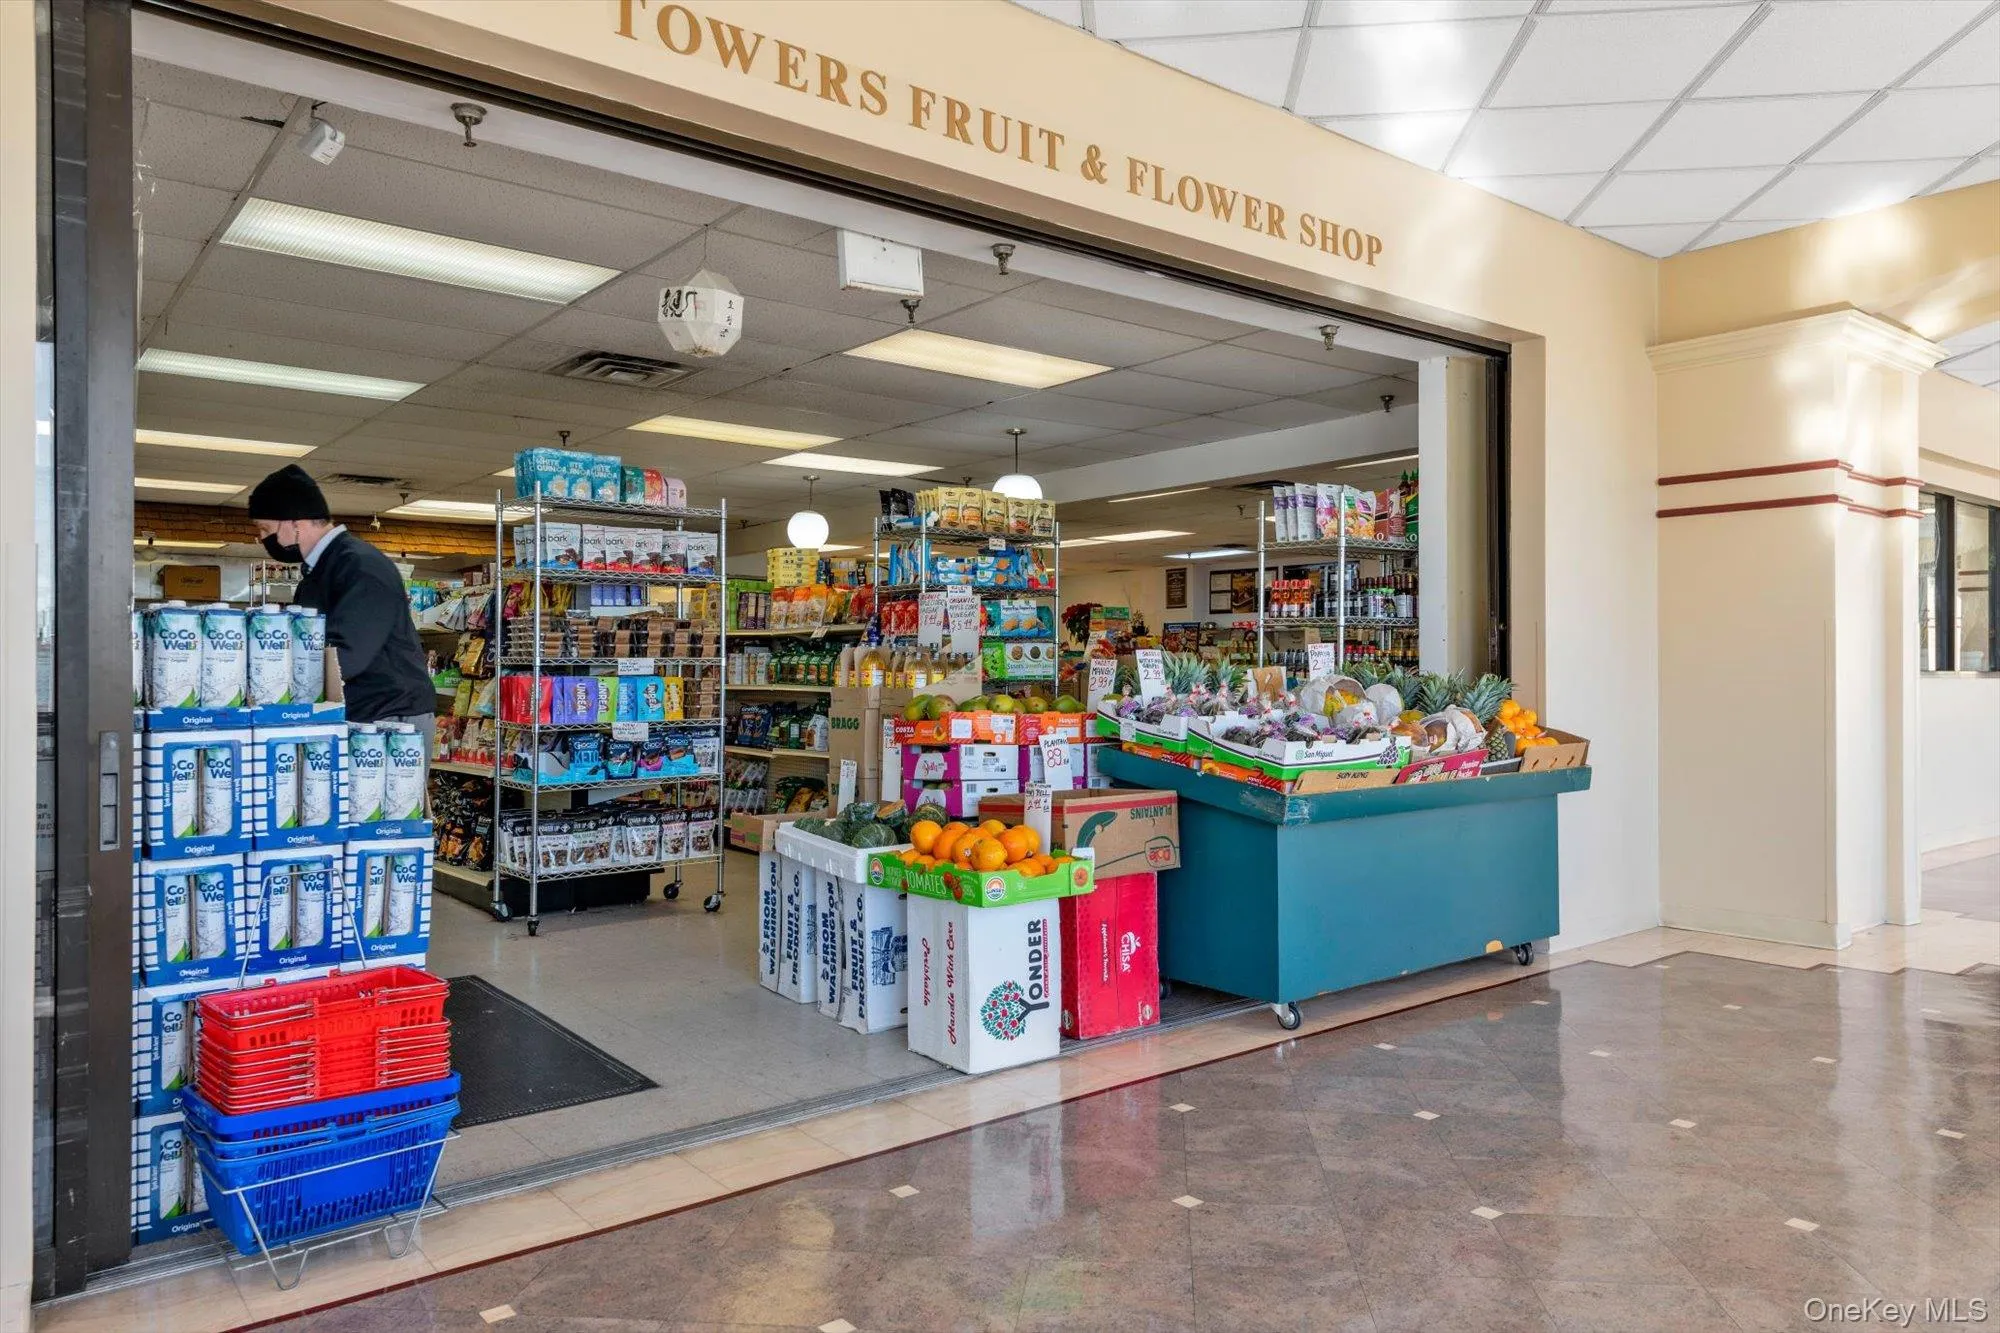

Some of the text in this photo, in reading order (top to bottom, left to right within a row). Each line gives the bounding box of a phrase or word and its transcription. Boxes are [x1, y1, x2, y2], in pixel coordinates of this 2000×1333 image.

[613, 0, 1383, 267] TOWERS FRUIT & FLOWER SHOP
[159, 629, 196, 640] CoCo
[207, 629, 242, 640] CoCo
[255, 629, 289, 640] CoCo
[576, 682, 587, 716] UNREAL
[182, 716, 213, 725] Original
[282, 711, 310, 720] Original
[831, 717, 860, 730] BRAGG
[307, 751, 331, 761] CoC
[352, 748, 383, 758] CoCo
[390, 748, 421, 758] CoCo
[1304, 749, 1334, 760] San Miguel
[207, 758, 232, 769] CoC
[1130, 804, 1172, 820] PLANTAINS
[375, 828, 402, 837] Original
[287, 834, 315, 844] Original
[184, 844, 215, 854] Original
[394, 863, 417, 874] CoC
[300, 872, 325, 883] CoC
[905, 869, 947, 895] TOMATES
[200, 880, 224, 893] CoC
[763, 890, 771, 940] FROM
[769, 861, 777, 975] WASHINGTON
[821, 912, 829, 965] FROM
[828, 882, 836, 1004] WASHINGTON
[370, 942, 397, 952] Original
[792, 905, 800, 985] PRODUCE
[850, 919, 859, 991] FRUIT &
[1120, 934, 1131, 973] CHISA
[279, 955, 307, 965] Original
[179, 967, 210, 977] Original
[858, 925, 866, 1019] PRODUCE
[922, 937, 931, 1007] Perishable
[1017, 918, 1050, 1022] YONDER
[945, 921, 957, 1045] Handle With Care
[171, 1221, 200, 1234] Origina
